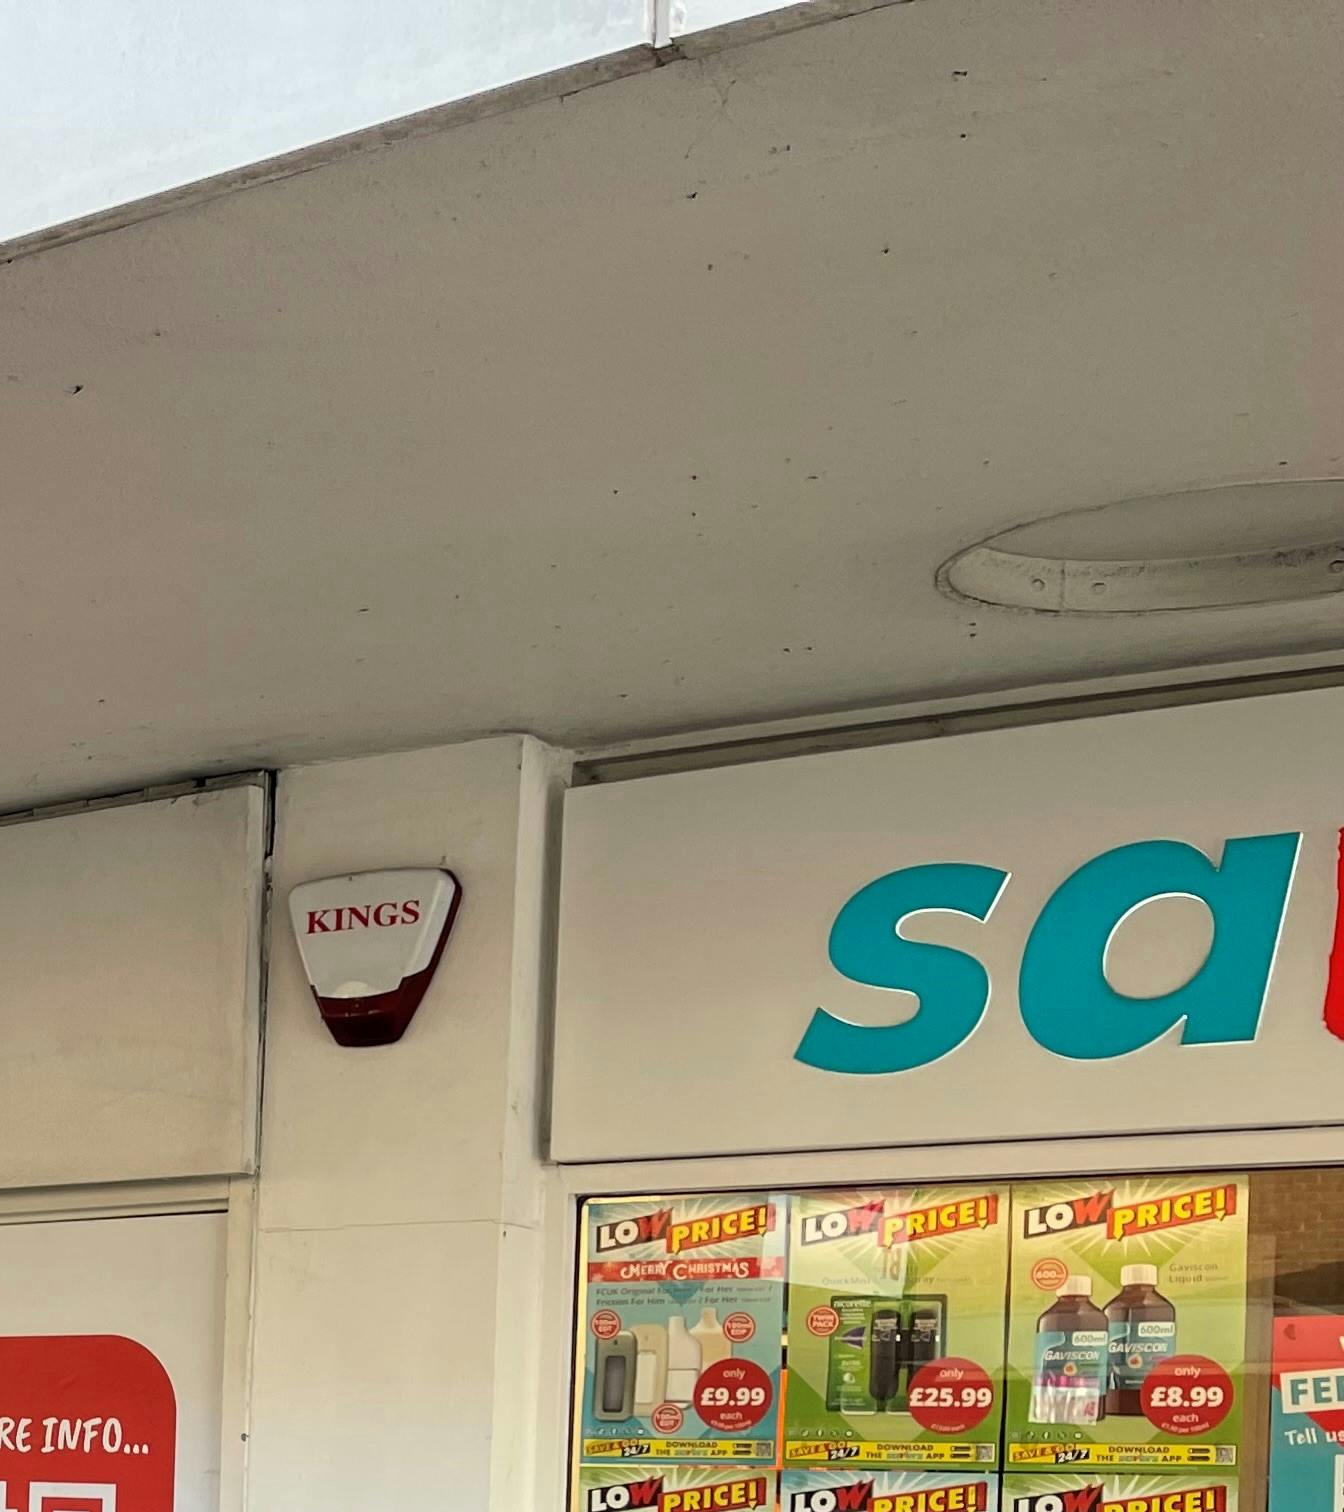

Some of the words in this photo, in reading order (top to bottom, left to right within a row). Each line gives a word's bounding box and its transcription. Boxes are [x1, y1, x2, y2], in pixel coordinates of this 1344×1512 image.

[307, 899, 421, 936] KINGS
[794, 831, 1344, 1077] sa
[1028, 1191, 1112, 1234] LOW
[1113, 1187, 1227, 1241] PRICE!
[599, 1208, 672, 1248] LOW
[671, 1206, 769, 1254] PRICE!
[805, 1202, 884, 1242] LOW
[883, 1198, 989, 1249] PRICE!
[620, 1261, 669, 1278] MERRY
[672, 1260, 749, 1280] CHRISTMAS
[1169, 1262, 1218, 1271] Gaviscon
[1169, 1274, 1202, 1284] Liquid
[1044, 1350, 1100, 1360] GAVISCON
[1108, 1342, 1168, 1353] GAVISCON
[723, 1369, 745, 1380] only
[939, 1368, 964, 1380] only
[1174, 1366, 1200, 1377] only
[701, 1387, 765, 1406] £9.99
[910, 1387, 992, 1408] £25.99
[1151, 1386, 1224, 1408] £8.99
[720, 1411, 743, 1420] each
[1173, 1412, 1199, 1423] each
[41, 1416, 149, 1455] INFO...
[1284, 1427, 1318, 1446] Tell
[830, 1446, 859, 1459] 24/7
[1057, 1450, 1089, 1463] 24/7
[1108, 1446, 1170, 1454] DOWNLOAD
[592, 1476, 664, 1512] LOW
